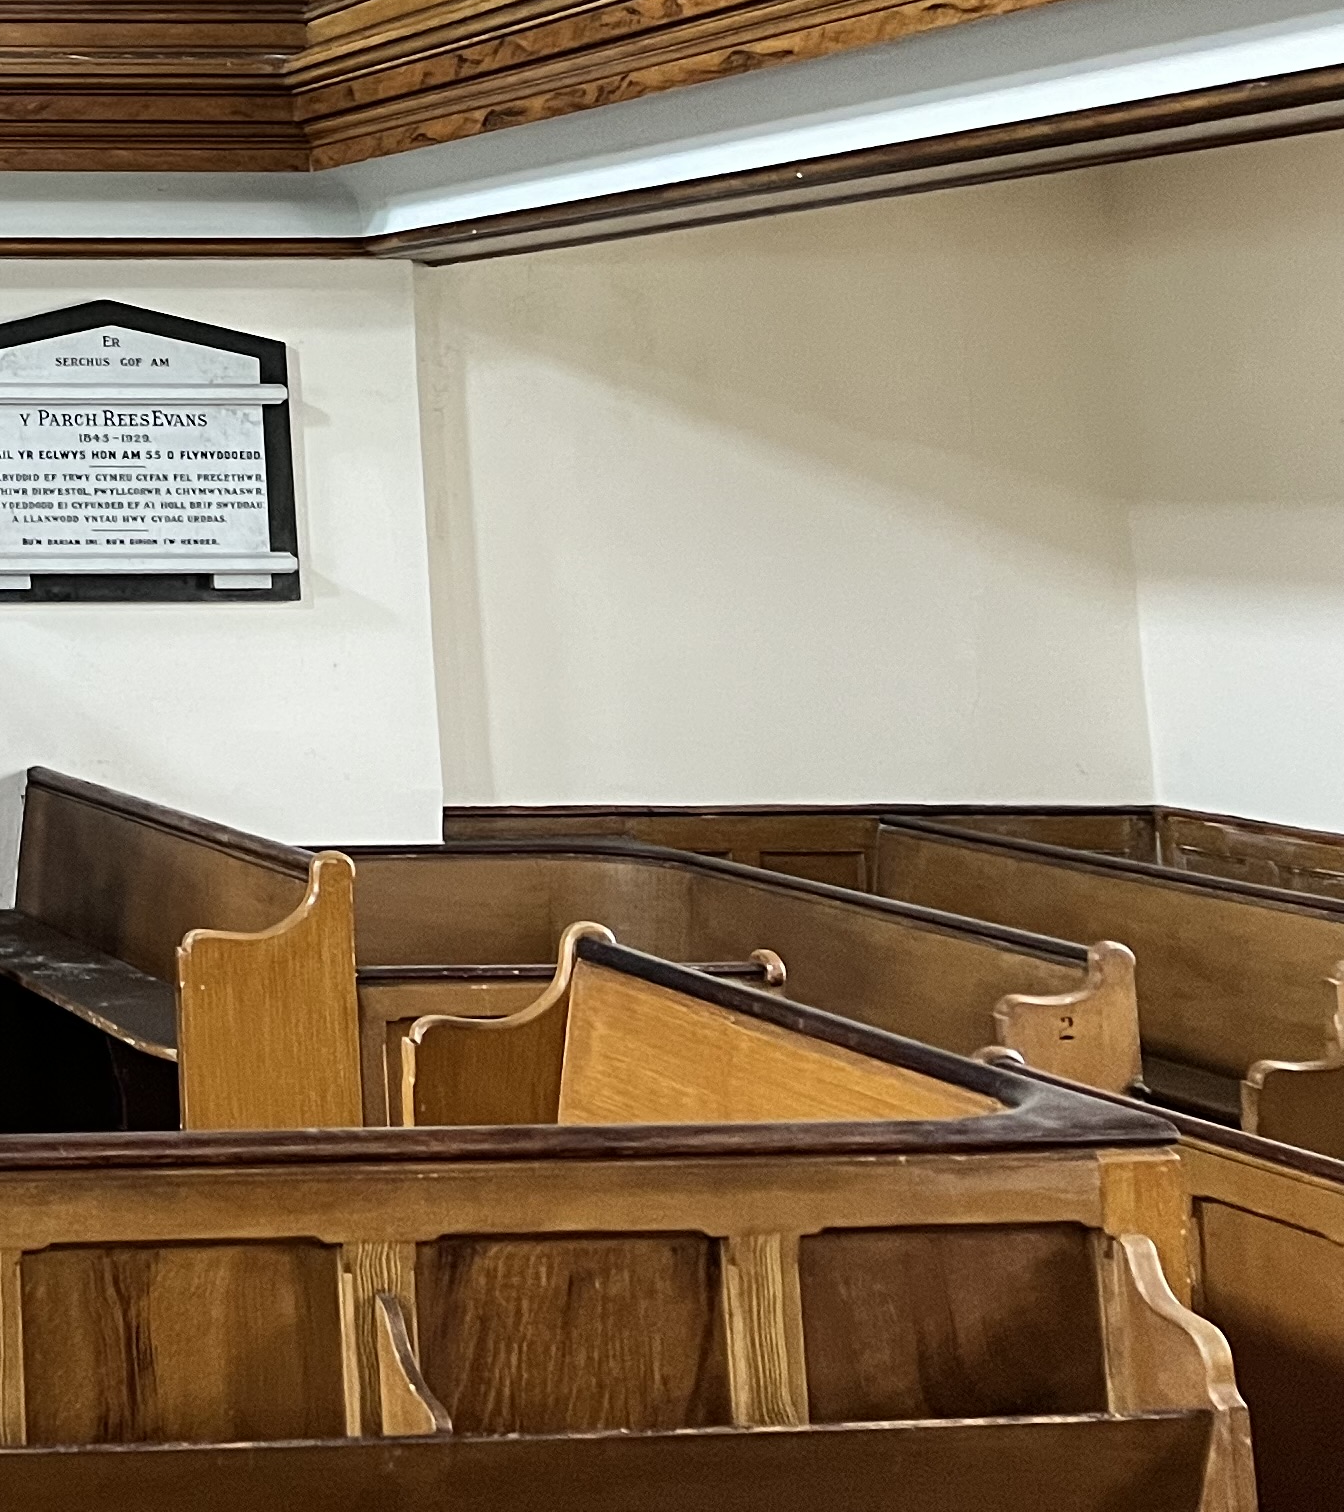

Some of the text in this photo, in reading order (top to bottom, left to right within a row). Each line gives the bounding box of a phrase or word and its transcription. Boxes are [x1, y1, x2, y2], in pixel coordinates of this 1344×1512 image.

[55, 357, 170, 367] SERCHUS GOF AM
[19, 413, 31, 427] Y
[18, 449, 34, 460] YR
[38, 449, 86, 460] EGLWYS
[91, 449, 117, 460] HON
[121, 449, 141, 460] AM
[145, 449, 162, 460] 55
[166, 449, 175, 460] O
[43, 472, 58, 483] EF
[62, 472, 91, 483] TRWY
[95, 472, 133, 483] GYMRU
[135, 472, 169, 483] GYFAN
[173, 472, 193, 483] FEL
[164, 487, 173, 496] A
[57, 501, 69, 510] EI
[127, 501, 141, 510] EF
[160, 501, 187, 510] HOLL
[12, 515, 20, 524] A
[23, 515, 80, 524] LLANWODD
[83, 515, 118, 524] YNTAU
[122, 515, 147, 524] HWY
[150, 515, 184, 524] GYDAG
